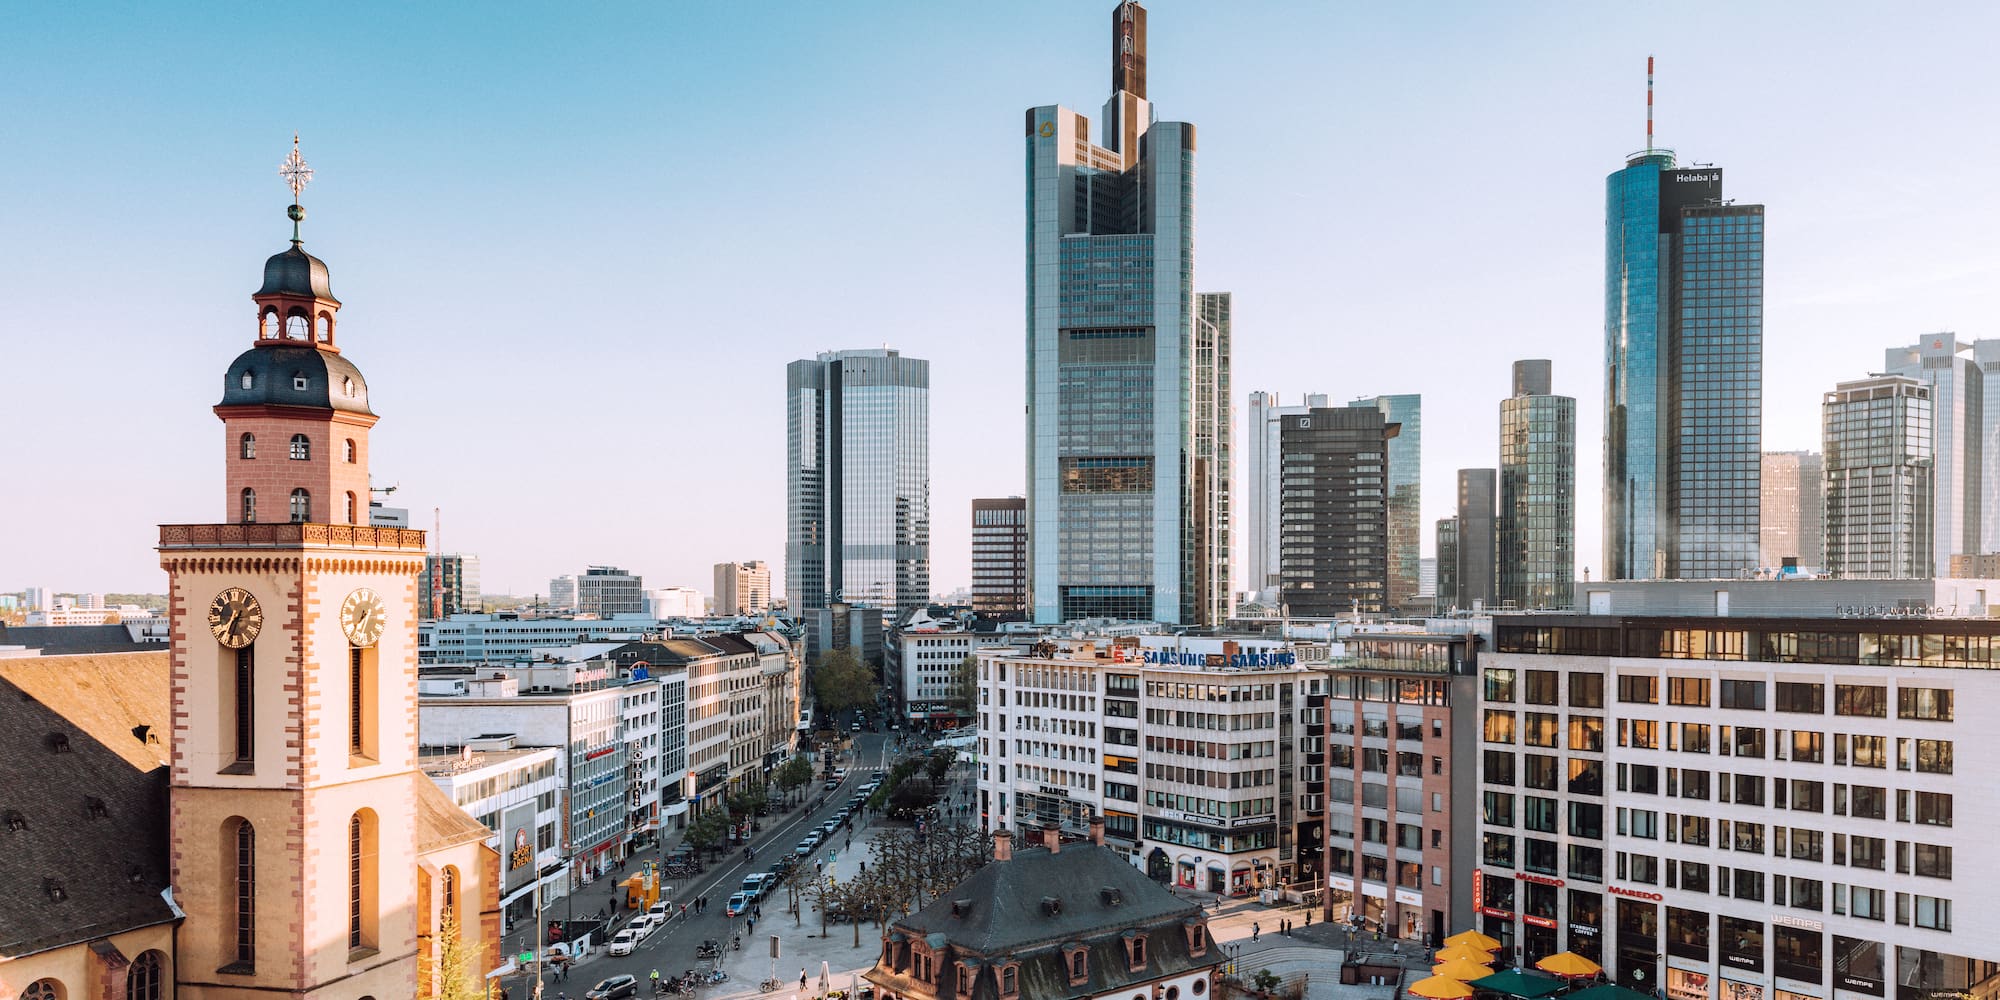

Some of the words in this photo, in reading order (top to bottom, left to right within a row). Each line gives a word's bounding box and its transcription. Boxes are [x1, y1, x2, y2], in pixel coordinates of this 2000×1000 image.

[1676, 173, 1708, 182] Helaba
[1836, 601, 1944, 616] hauptwache
[1143, 650, 1207, 667] SAMSUNG
[1230, 652, 1296, 668] SAMSUNG
[634, 740, 642, 789] HOTEL
[1040, 785, 1069, 797] PRANGE
[513, 844, 534, 860] SPORT
[512, 855, 534, 871] ARENA
[1516, 872, 1565, 888] MAREDO
[1608, 885, 1663, 902] MAREDO
[1569, 923, 1599, 933] STARBUCKS
[1771, 914, 1823, 931] WEMPE
[1574, 929, 1593, 937] COFFEE
[1729, 955, 1754, 966] WEMPE
[1844, 978, 1873, 989] WEMPE
